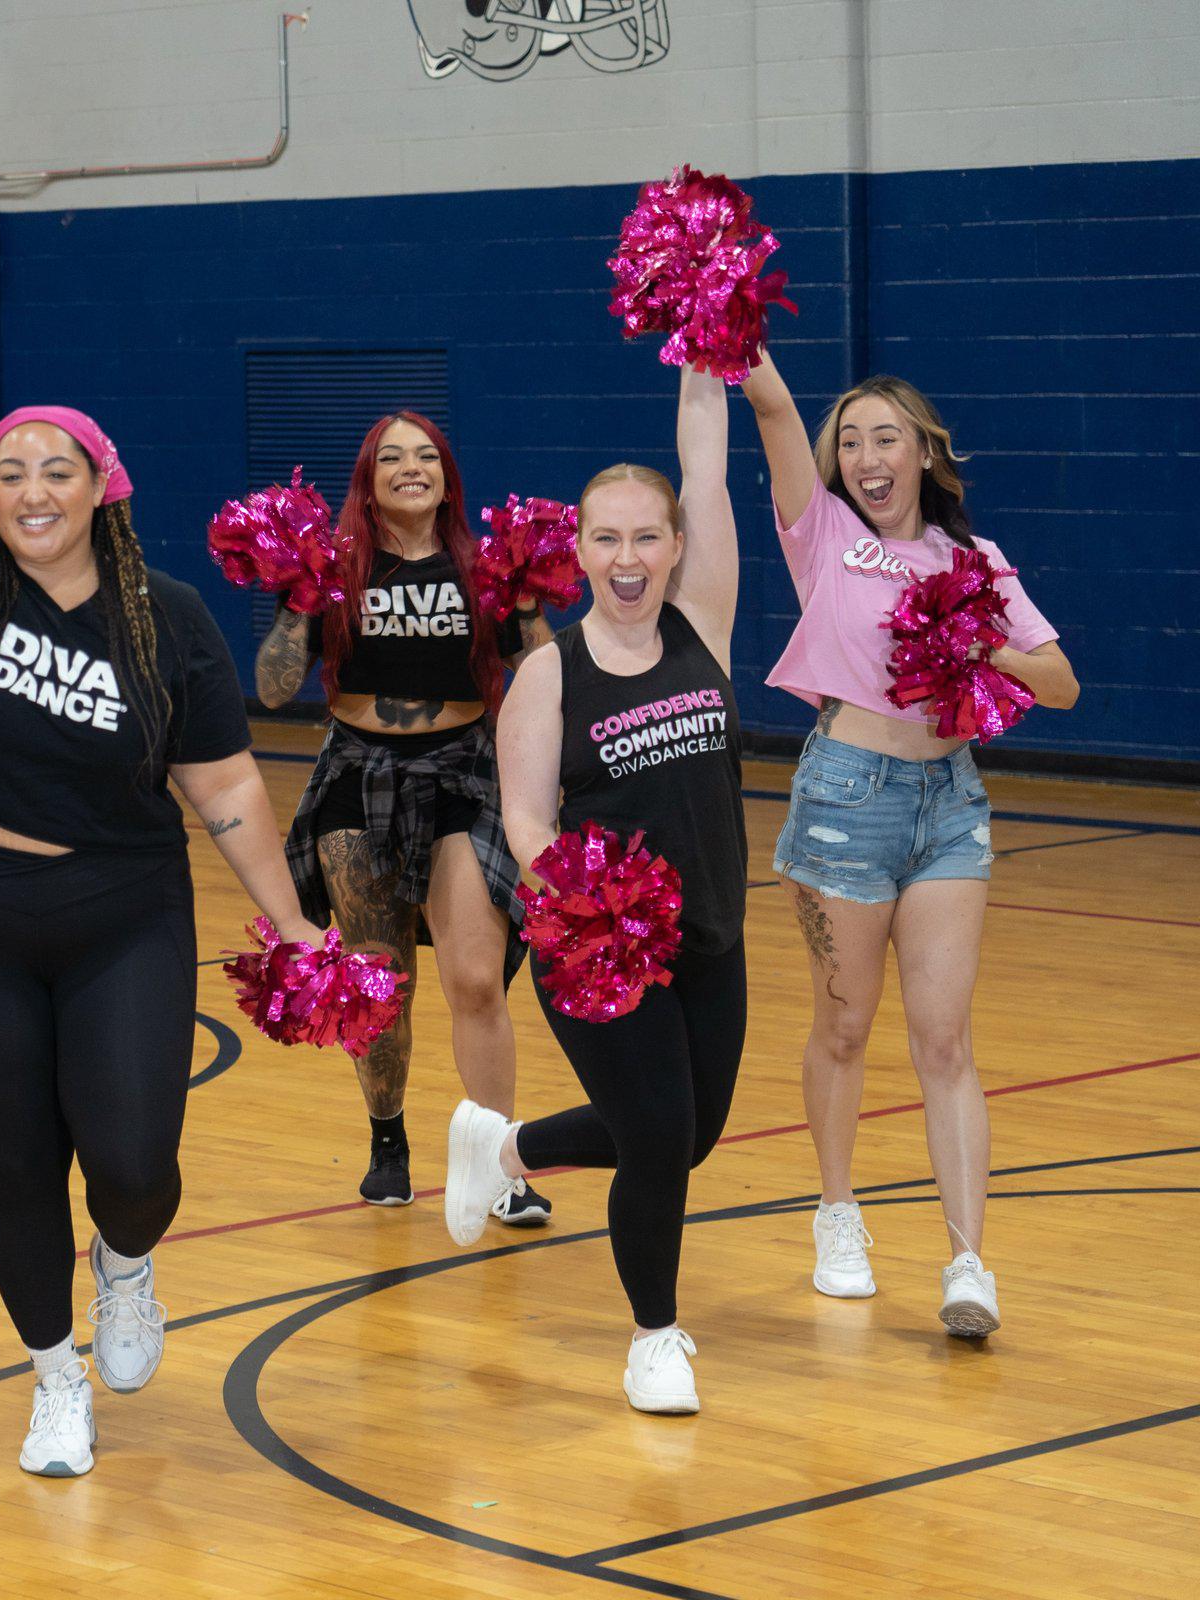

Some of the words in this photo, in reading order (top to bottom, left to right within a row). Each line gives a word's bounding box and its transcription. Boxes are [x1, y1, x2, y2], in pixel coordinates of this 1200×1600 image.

[360, 582, 465, 615] DIVA
[360, 613, 469, 637] DANCE
[0, 622, 120, 700] DIVA
[589, 689, 724, 743] CONFIDENCE
[599, 711, 727, 764] COMMUNITY
[608, 737, 709, 779] DIVADANCE
